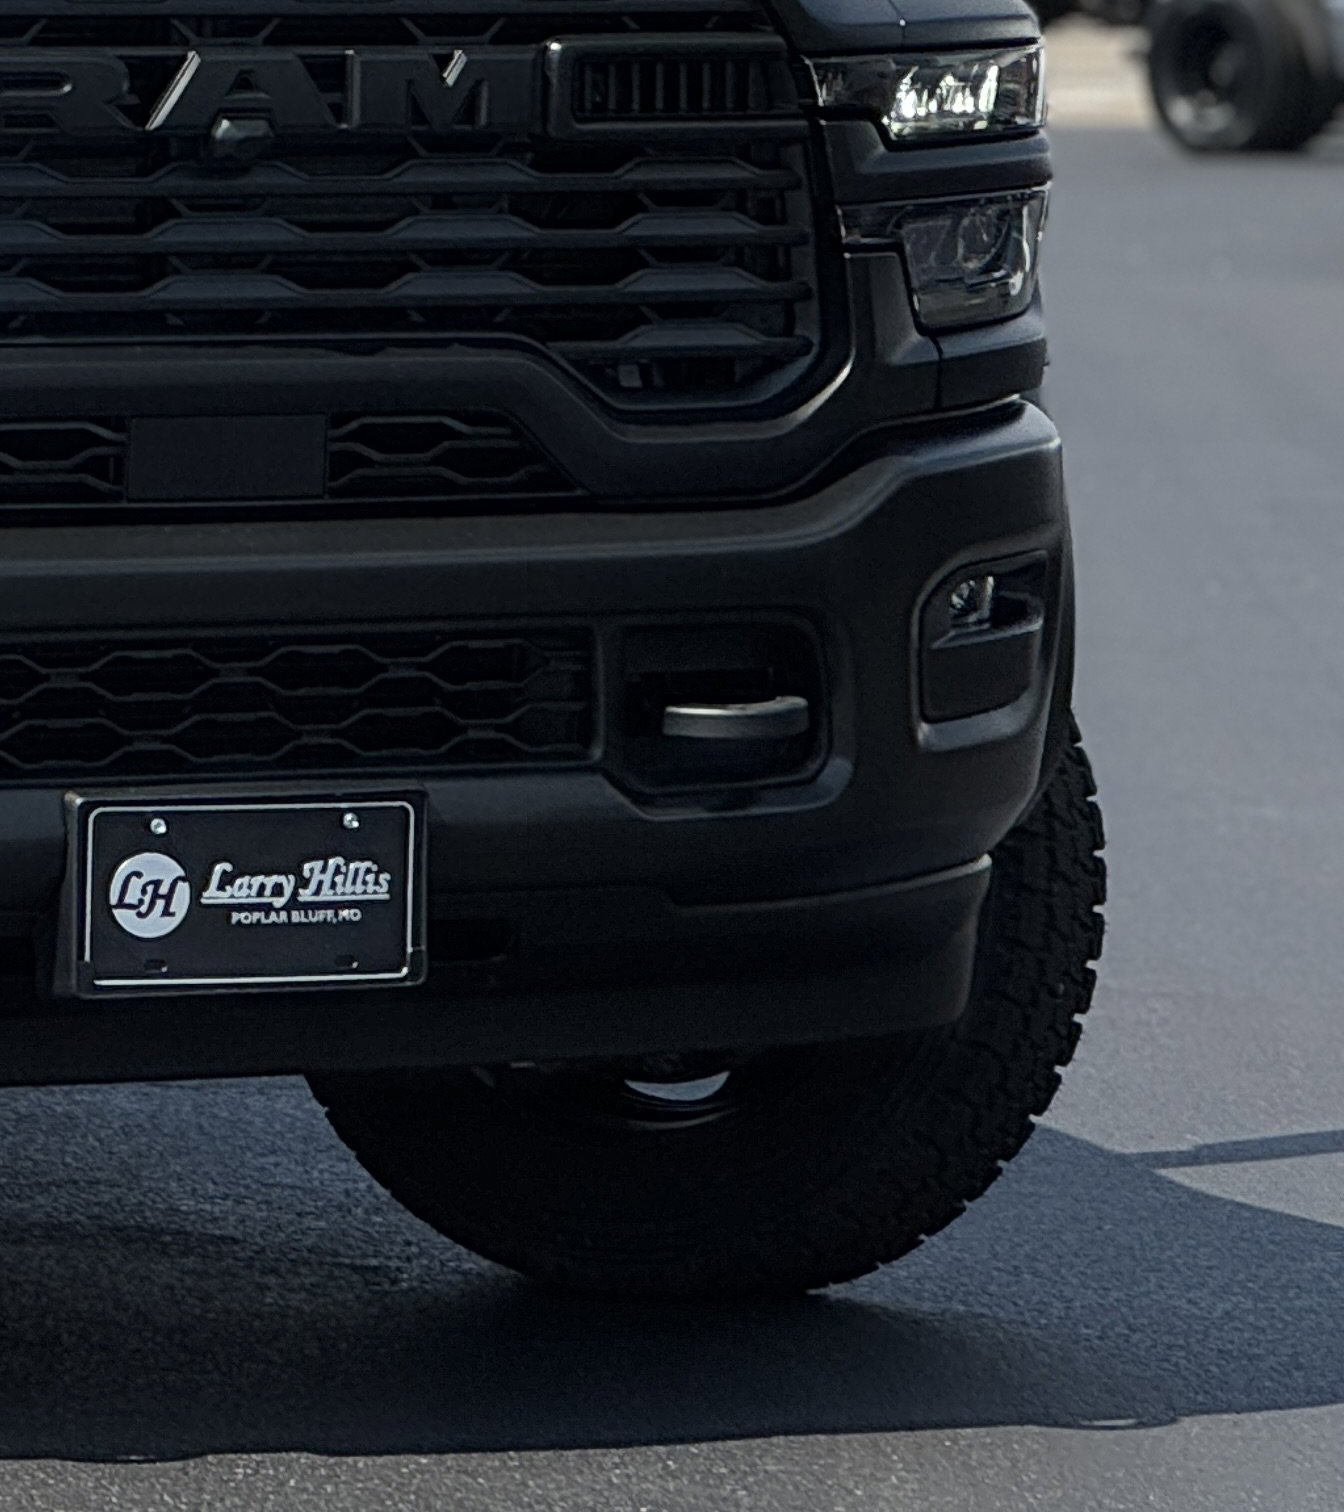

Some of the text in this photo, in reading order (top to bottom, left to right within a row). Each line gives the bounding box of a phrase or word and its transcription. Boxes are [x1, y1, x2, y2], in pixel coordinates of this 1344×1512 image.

[200, 855, 392, 908] Larry Hillis
[230, 910, 288, 925] POPLAR
